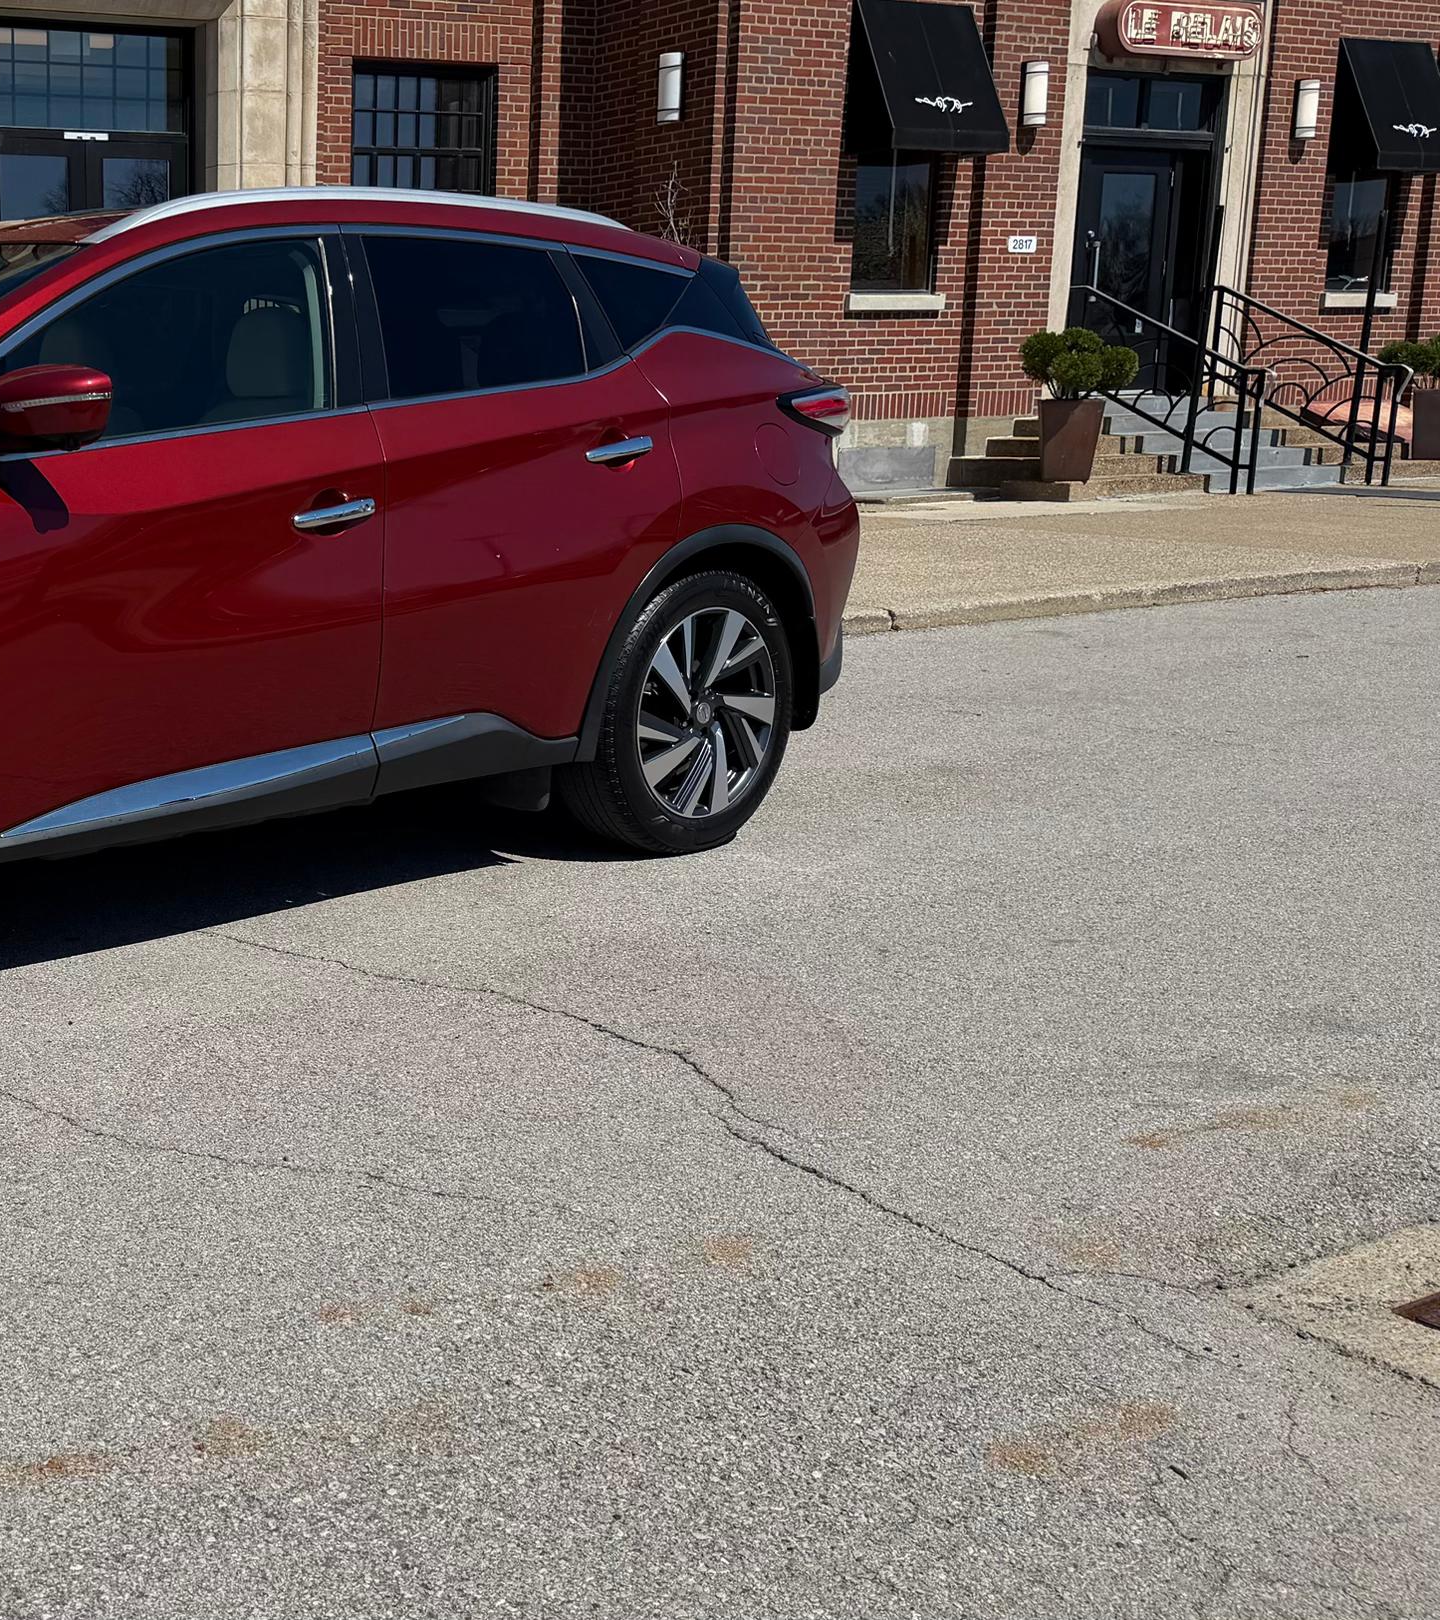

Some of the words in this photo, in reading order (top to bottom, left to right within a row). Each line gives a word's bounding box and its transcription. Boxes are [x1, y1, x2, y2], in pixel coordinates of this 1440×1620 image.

[1128, 8, 1158, 40] LE
[1171, 11, 1259, 47] RELAIS
[1012, 238, 1033, 250] 2817
